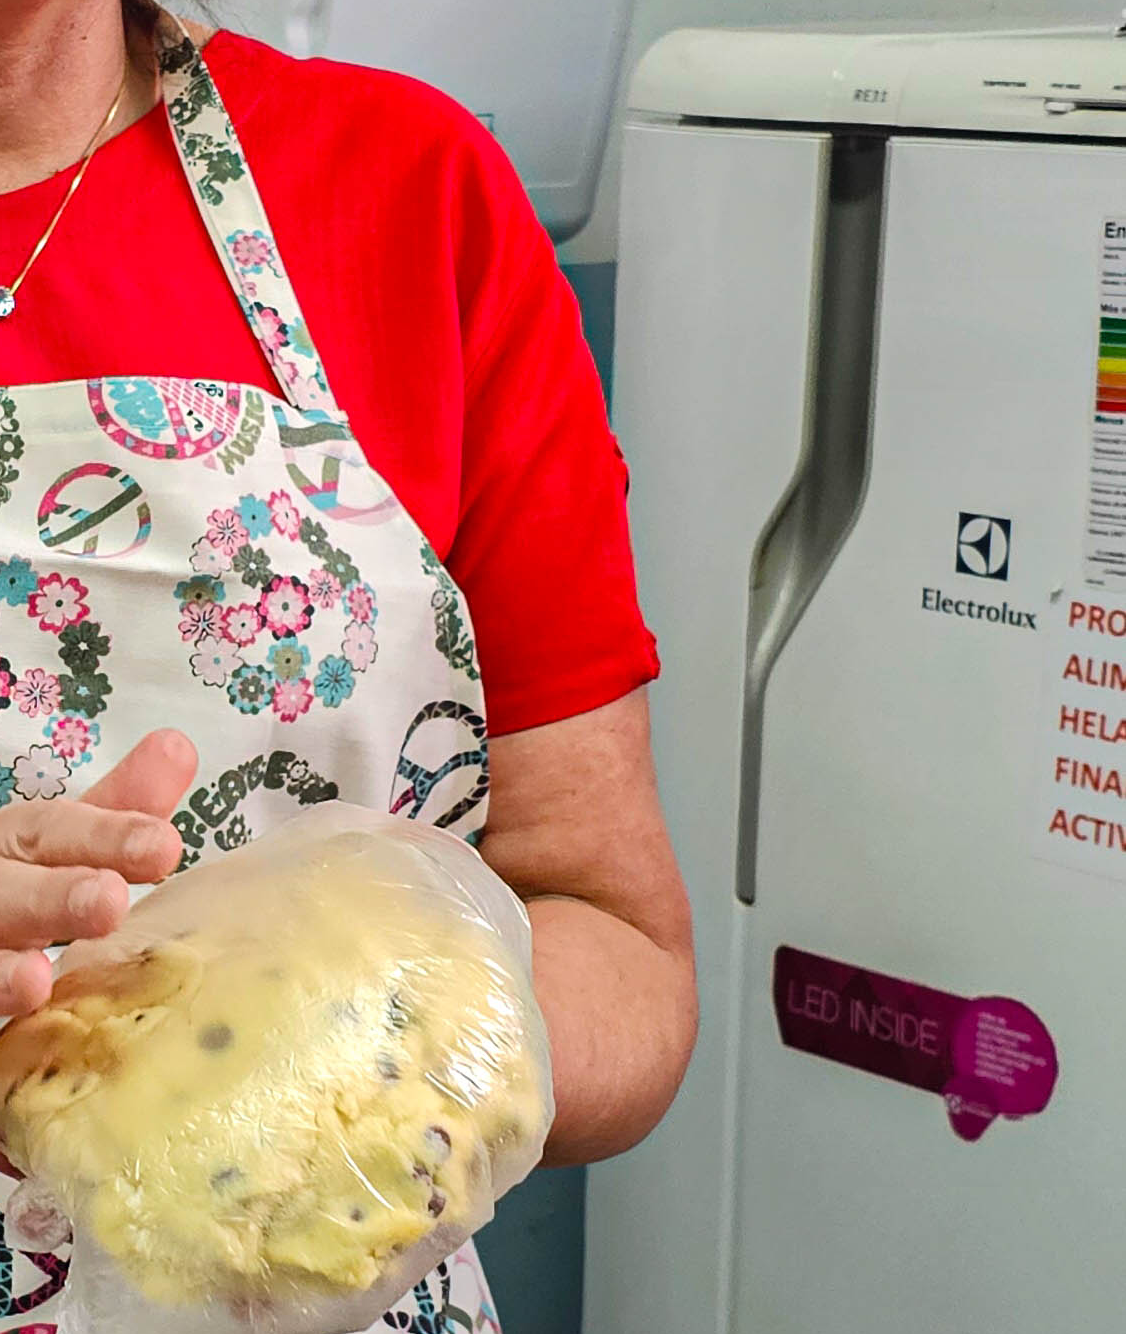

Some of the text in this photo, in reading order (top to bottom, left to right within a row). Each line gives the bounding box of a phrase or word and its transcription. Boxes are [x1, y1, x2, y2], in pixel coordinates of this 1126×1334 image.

[216, 390, 266, 476] MUSIC
[921, 587, 1036, 630] Electrolux
[1068, 601, 1126, 637] PRO
[1058, 704, 1126, 744] HELA
[1054, 756, 1126, 800] FINA
[787, 980, 841, 1024] LED
[849, 999, 940, 1057] INSIDE
